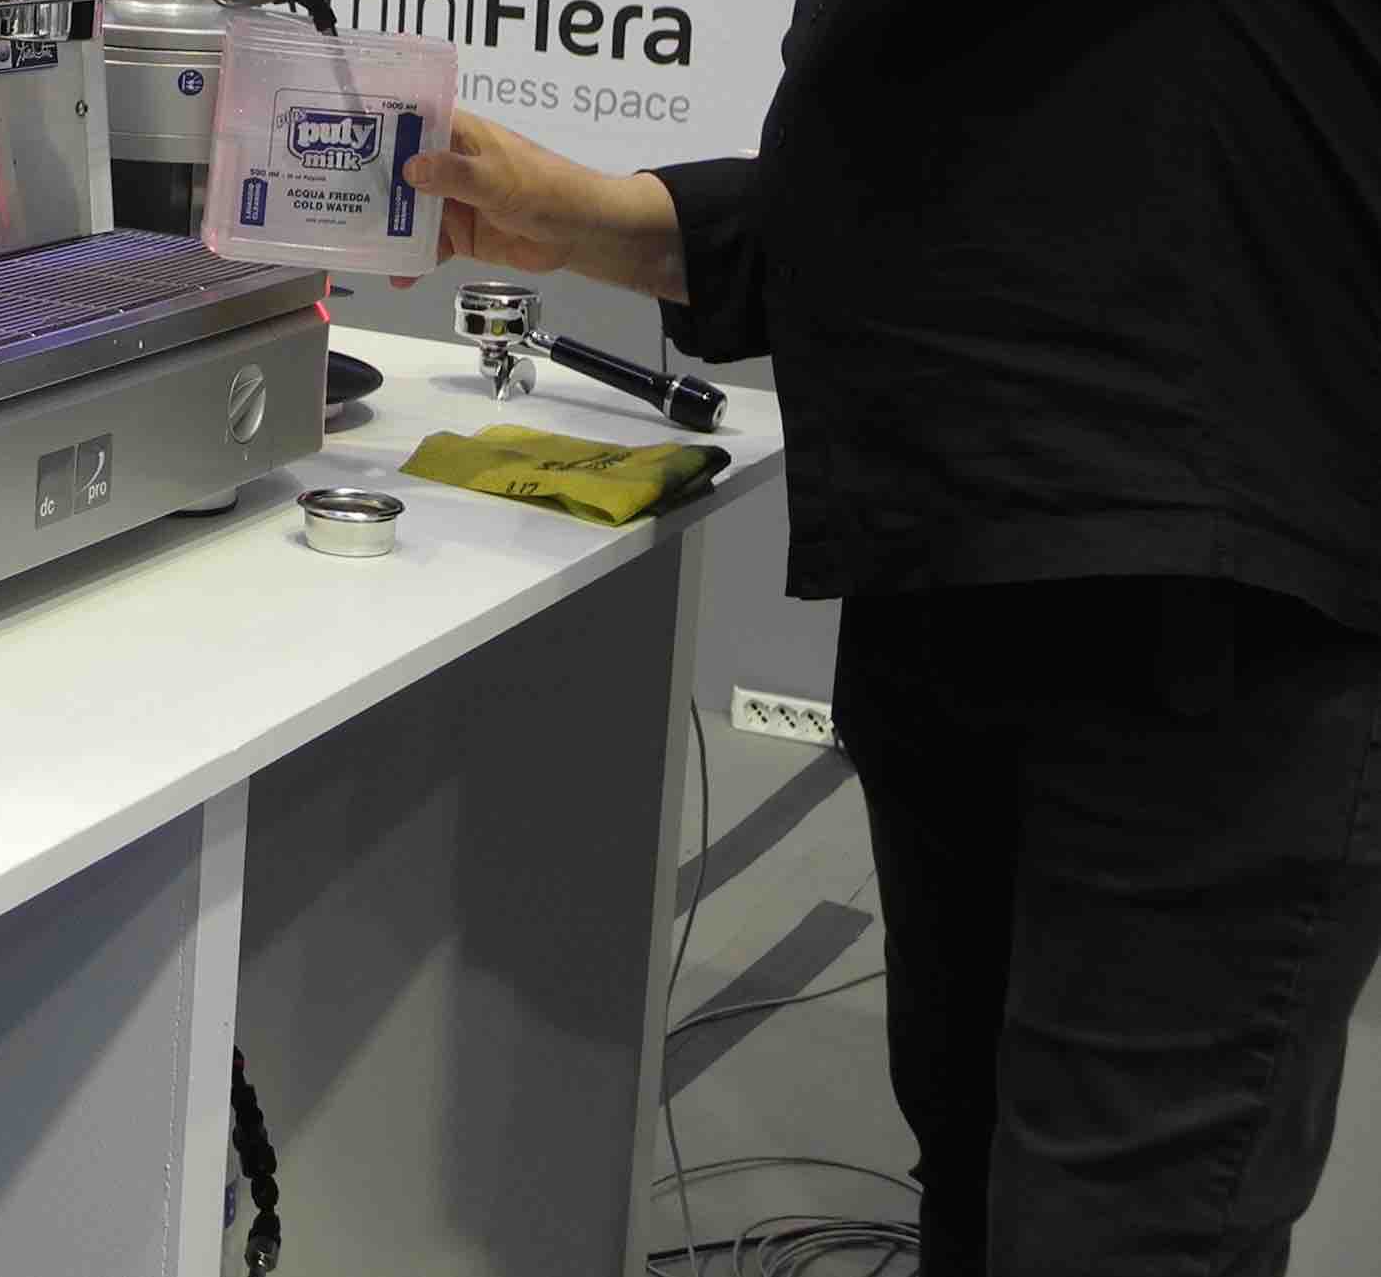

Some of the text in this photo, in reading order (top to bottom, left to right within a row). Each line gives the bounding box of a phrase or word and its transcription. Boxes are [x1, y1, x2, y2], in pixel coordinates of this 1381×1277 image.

[461, 72, 691, 123] iness space
[297, 118, 374, 148] puly
[302, 149, 362, 172] milk
[287, 188, 325, 200] ACQUA
[293, 200, 363, 213] COLD WATER
[88, 481, 107, 504] pro
[40, 496, 55, 517] dc
